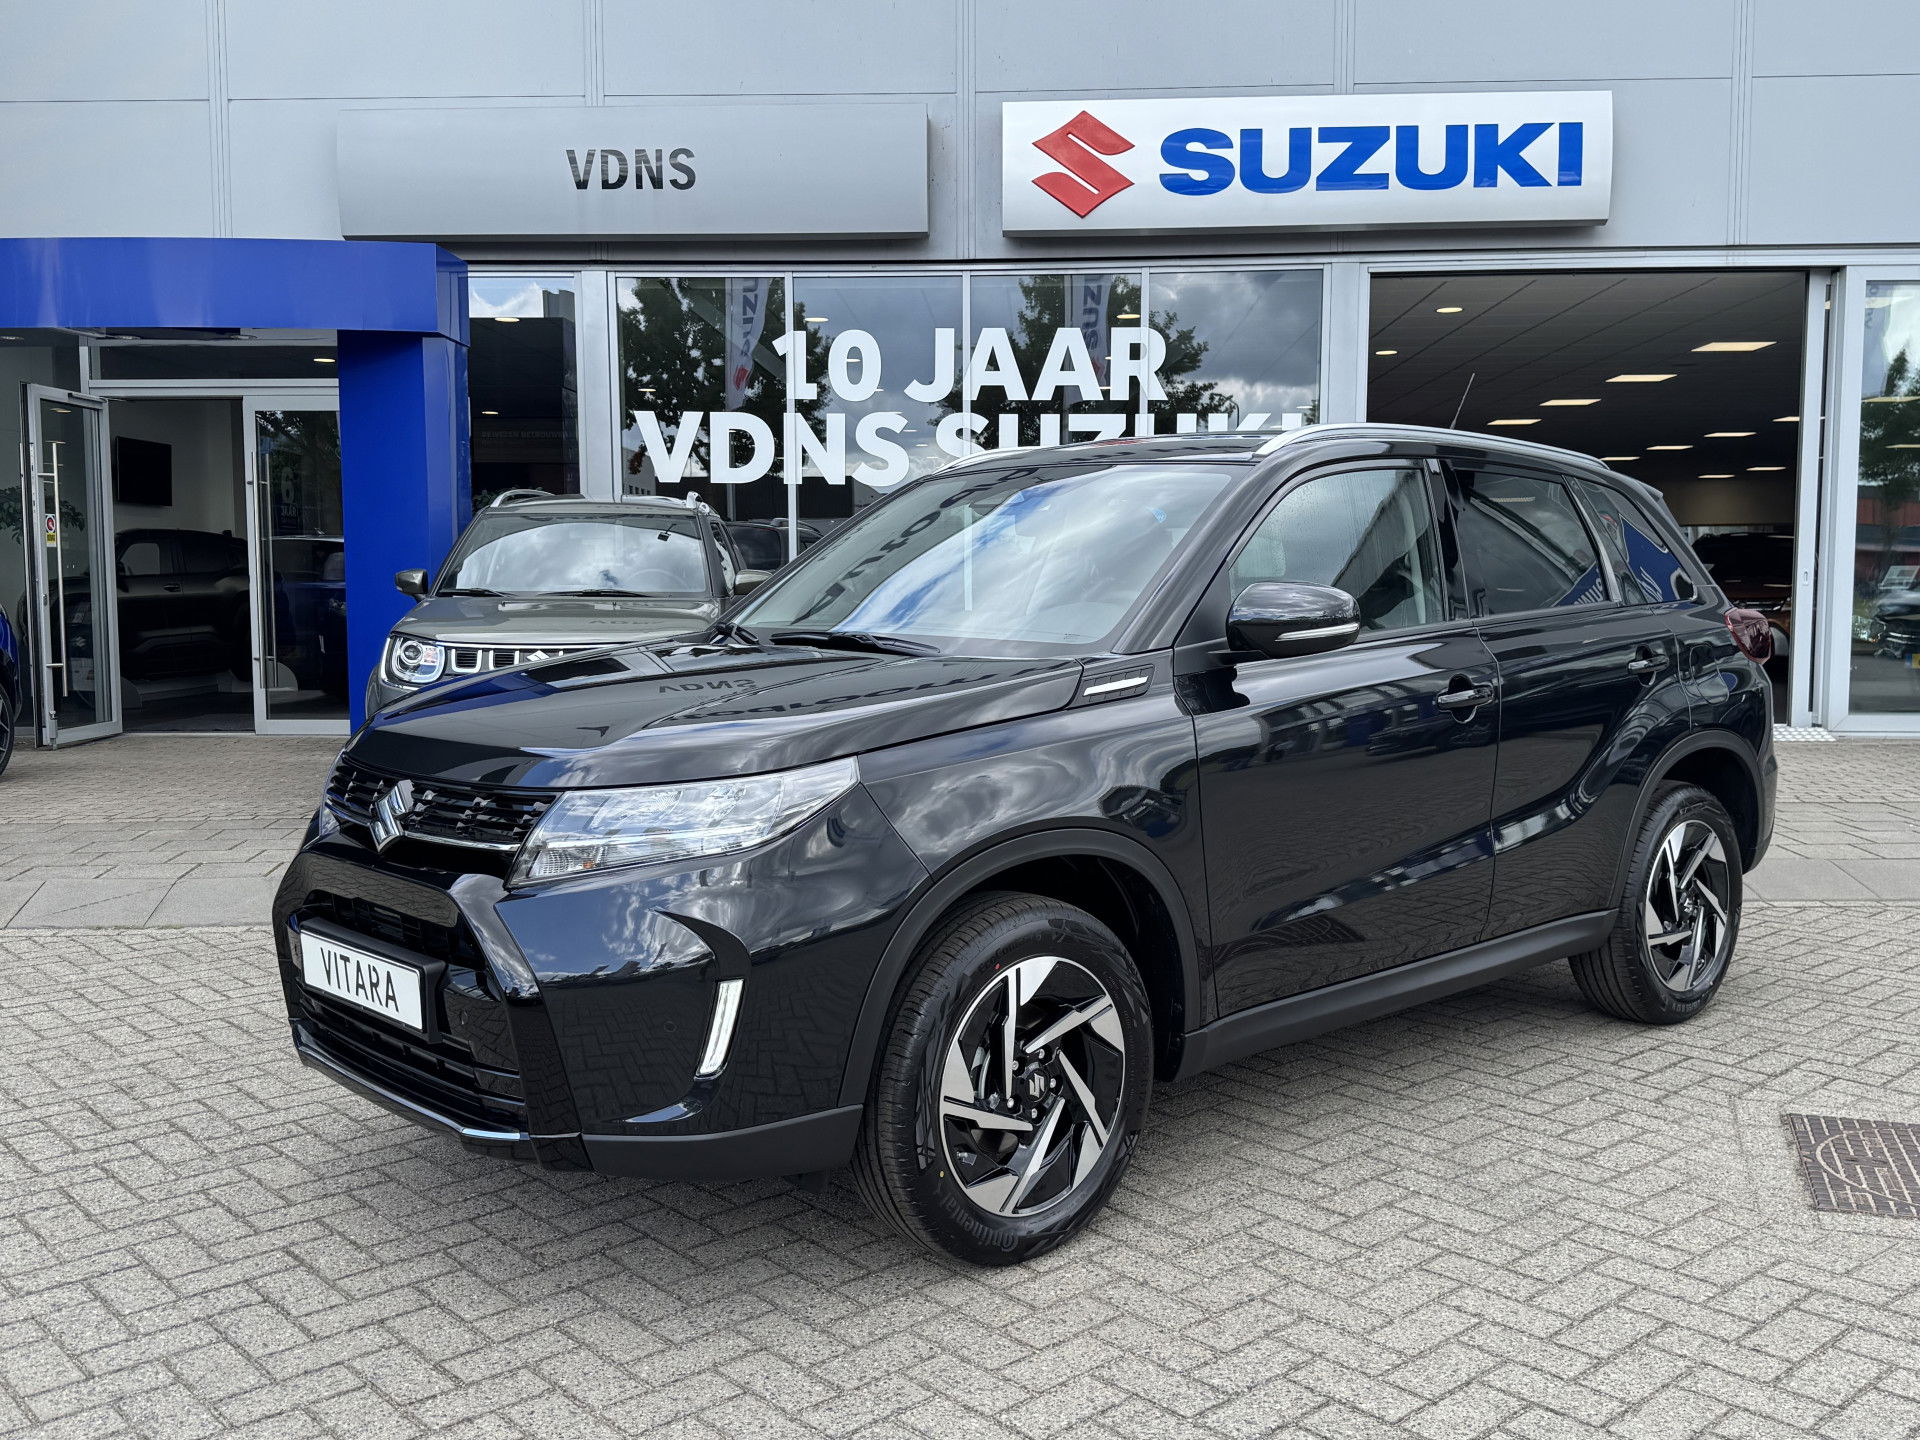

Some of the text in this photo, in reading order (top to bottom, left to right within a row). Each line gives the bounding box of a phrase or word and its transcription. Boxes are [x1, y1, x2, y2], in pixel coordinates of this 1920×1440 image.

[566, 148, 696, 190] VDNS
[1160, 122, 1583, 196] SUZUKI
[772, 327, 1168, 403] 10 JAAR
[634, 411, 910, 487] VDNS
[320, 947, 399, 1013] VITARA
